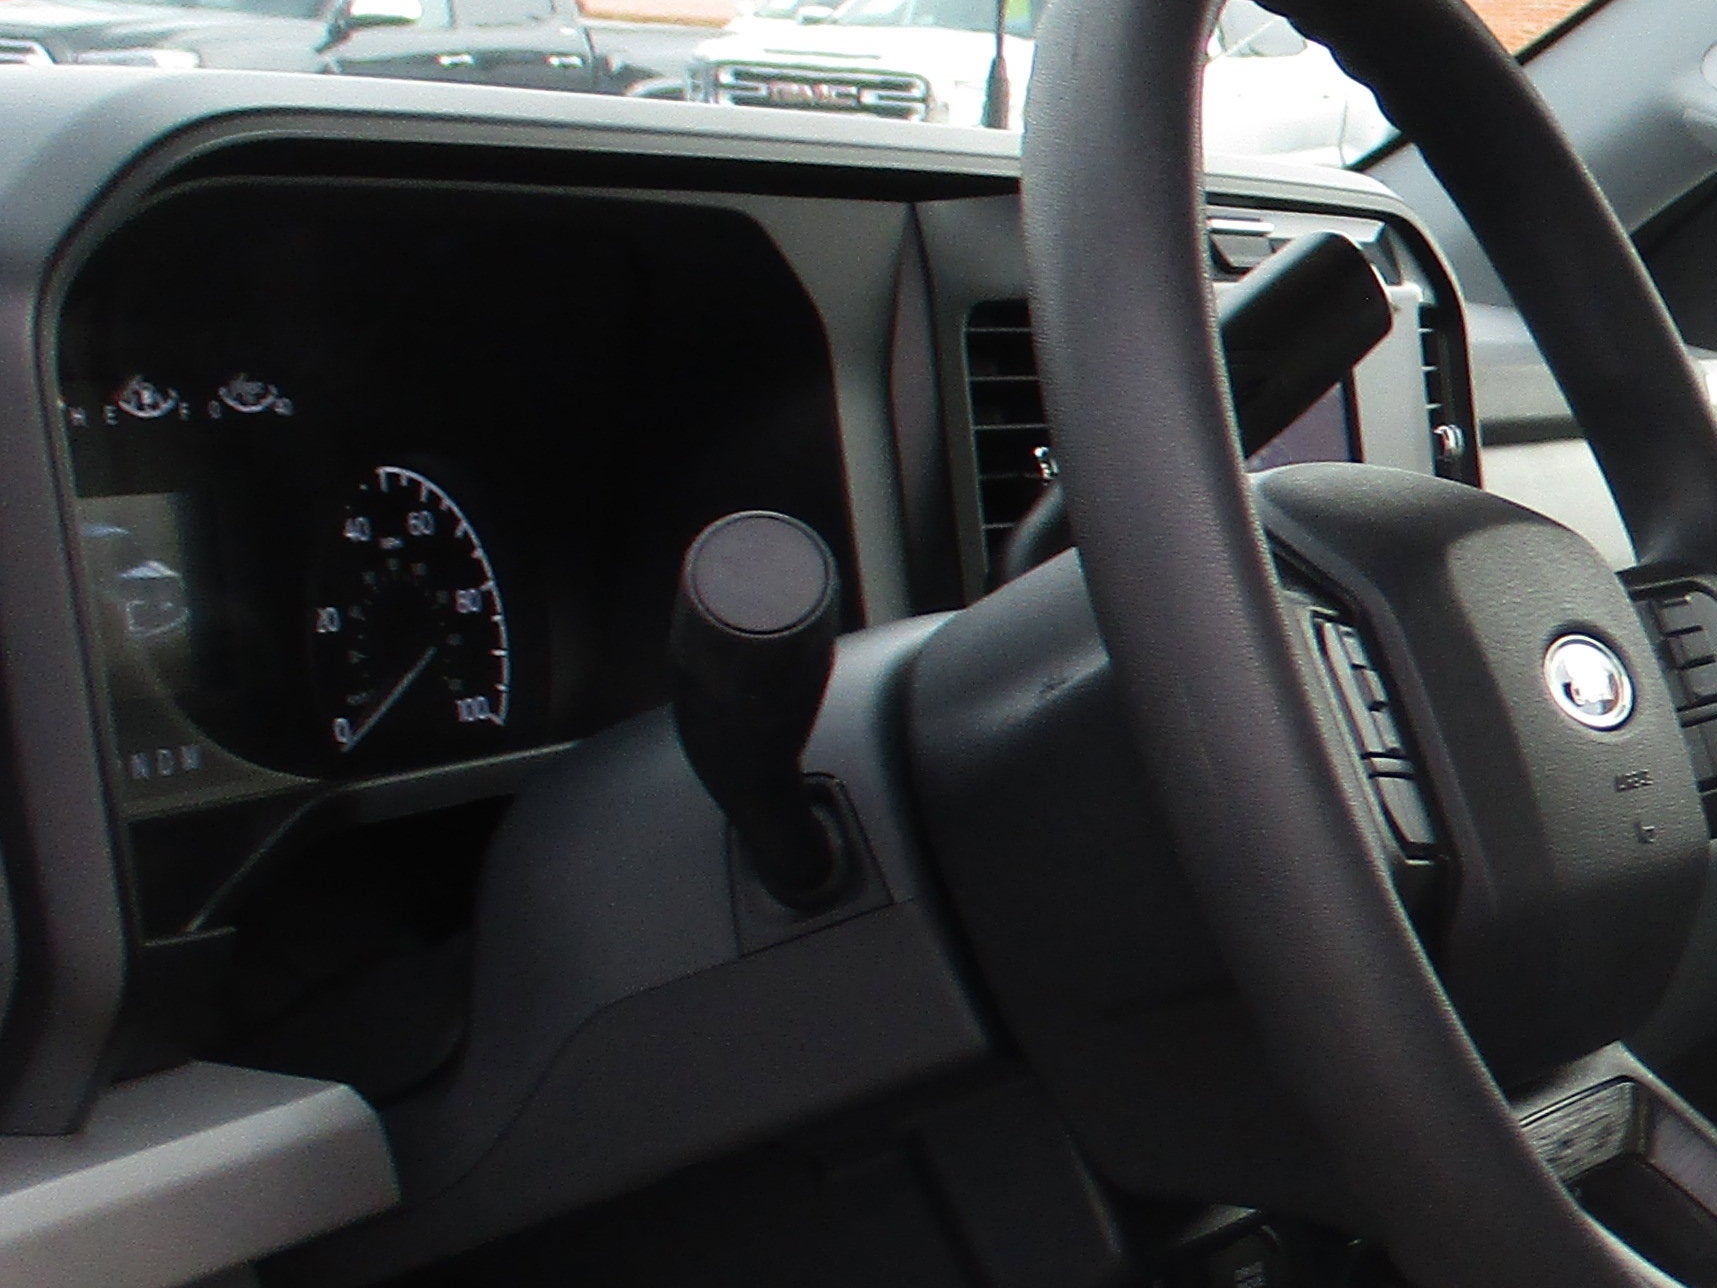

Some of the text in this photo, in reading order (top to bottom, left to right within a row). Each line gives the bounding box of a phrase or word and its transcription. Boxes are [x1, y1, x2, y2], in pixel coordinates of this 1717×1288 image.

[343, 516, 372, 542] 40
[407, 510, 434, 536] 60
[455, 588, 482, 614] 80
[316, 607, 341, 633] 20
[457, 696, 490, 723] 100
